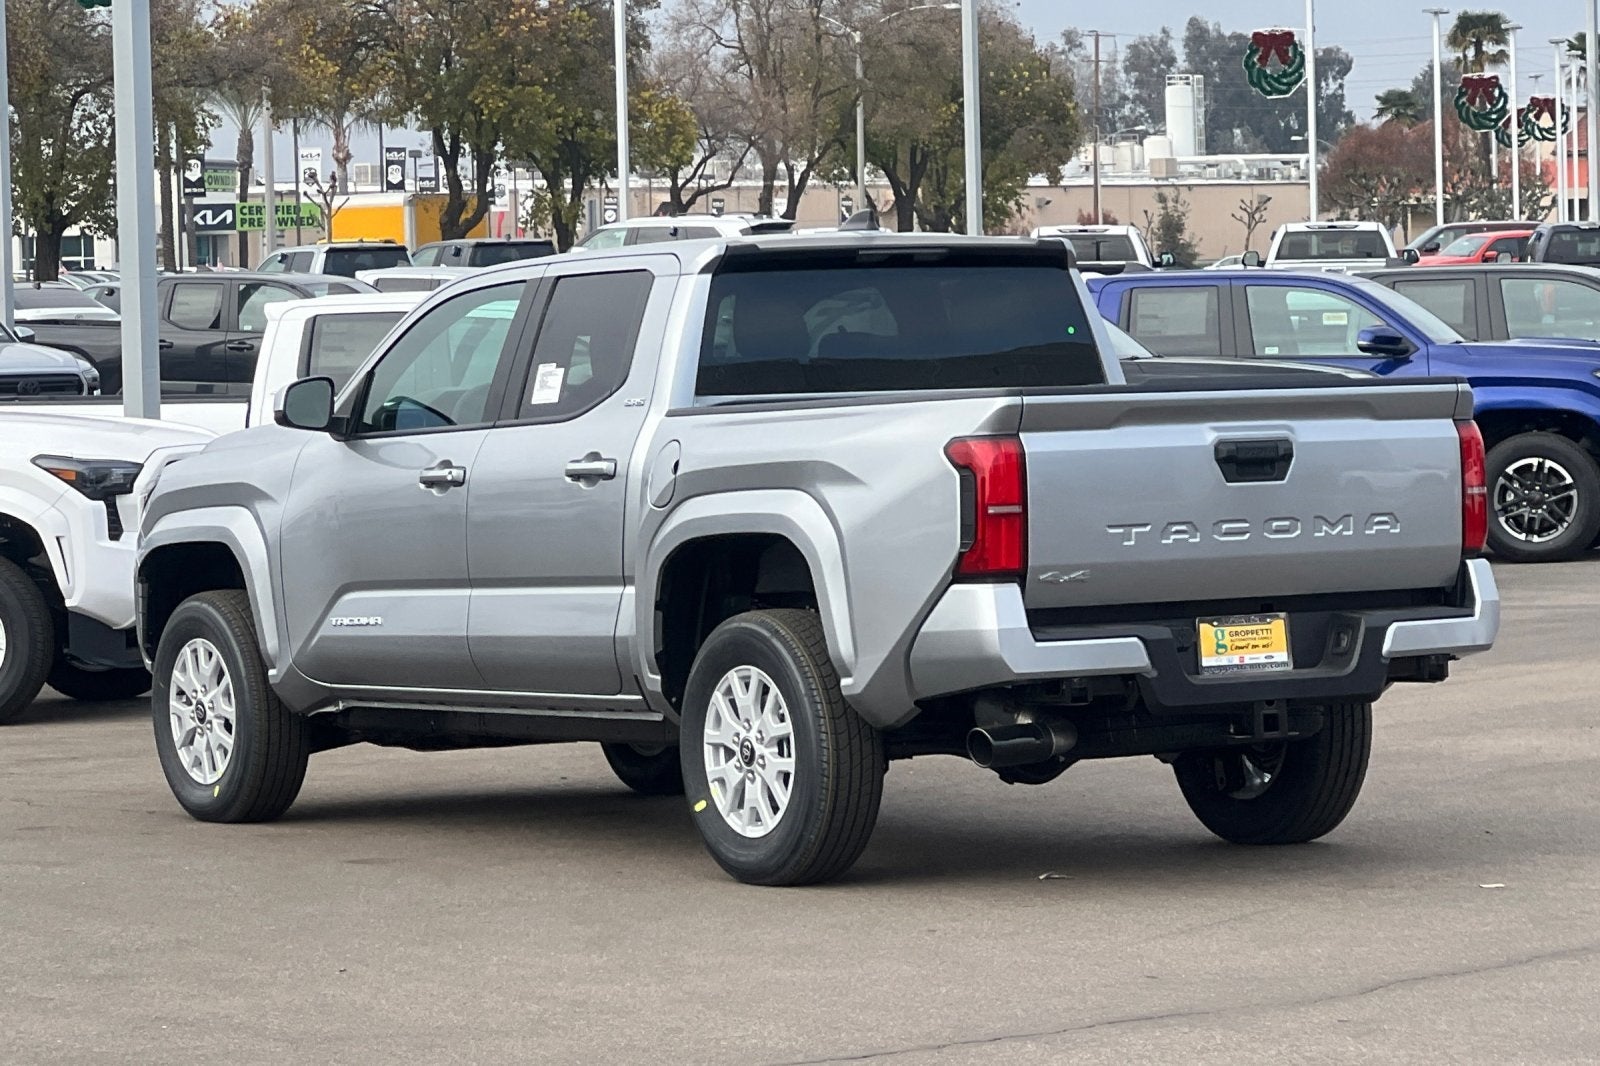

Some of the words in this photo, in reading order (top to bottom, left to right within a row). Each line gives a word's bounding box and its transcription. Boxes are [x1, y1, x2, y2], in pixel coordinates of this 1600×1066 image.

[389, 167, 400, 175] 20
[193, 209, 233, 225] KIA
[240, 216, 314, 228] PRE-WNED
[1106, 511, 1401, 546] TACOMA
[330, 616, 382, 626] TACOMA
[1228, 628, 1272, 637] GROPPETTI
